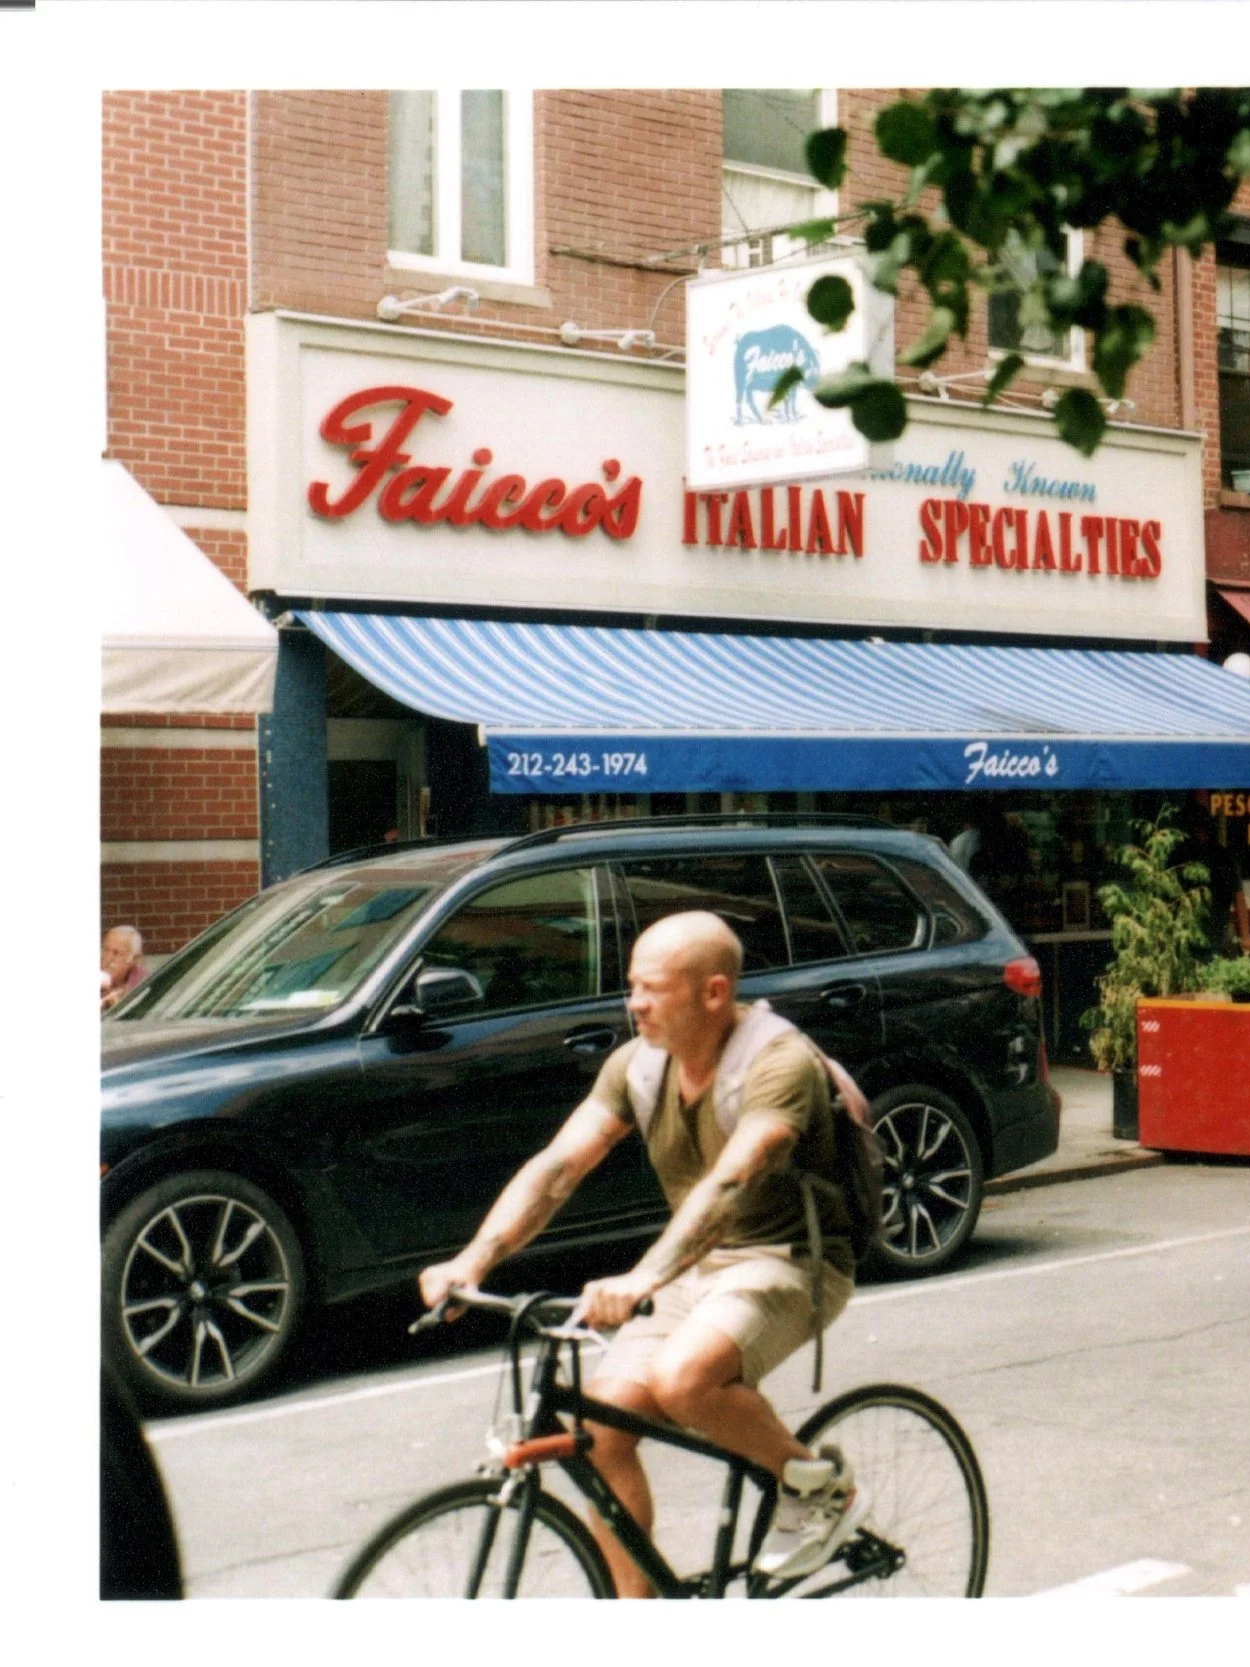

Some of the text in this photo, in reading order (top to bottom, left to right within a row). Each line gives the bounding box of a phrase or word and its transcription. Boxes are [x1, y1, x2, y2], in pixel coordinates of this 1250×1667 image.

[743, 339, 806, 386] Faicco's
[307, 385, 643, 541] Faicco's
[1003, 458, 1098, 502] Known
[682, 484, 1163, 579] ITALIAN SPECIALTIES
[507, 752, 648, 777] 212-243-1974
[963, 741, 1060, 784] Faicco's
